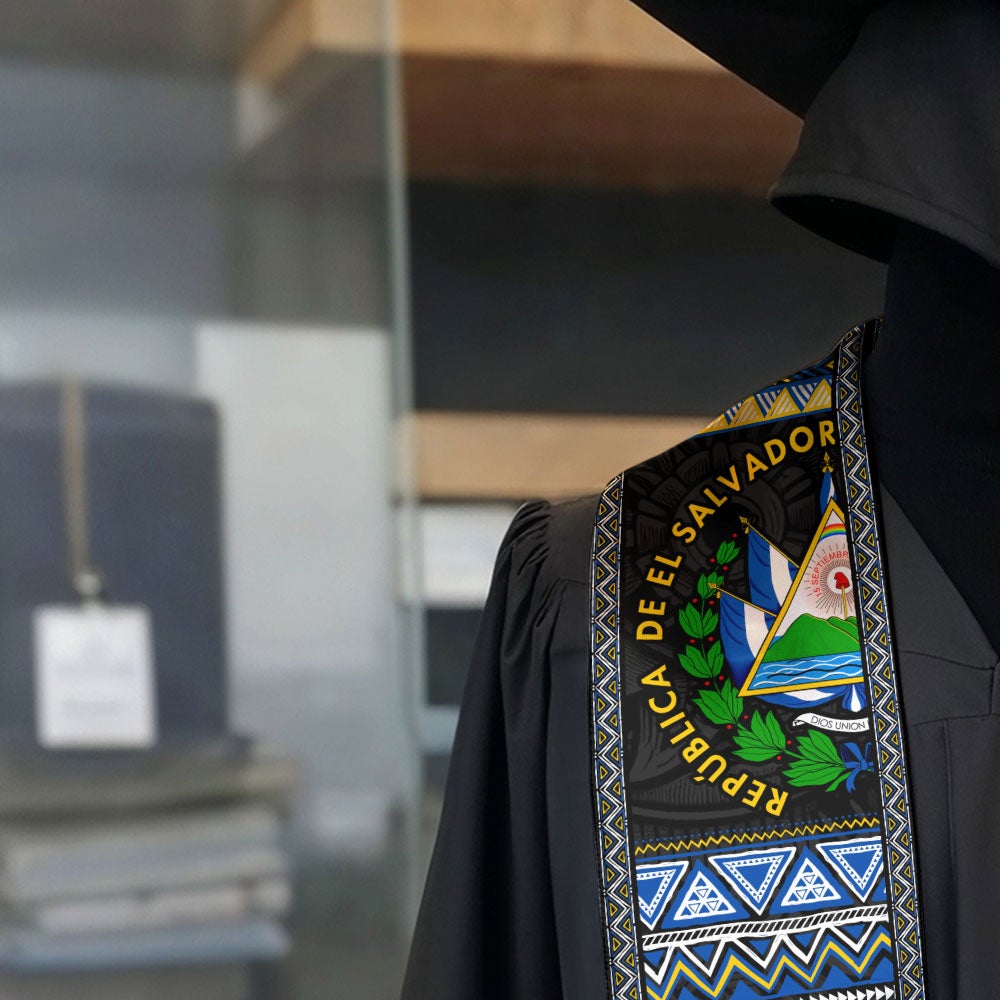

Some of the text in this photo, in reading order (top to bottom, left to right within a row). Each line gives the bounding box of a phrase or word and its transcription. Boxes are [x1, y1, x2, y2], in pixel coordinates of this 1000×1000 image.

[636, 420, 836, 816] REPÚBLICA DE EL SALVADOR
[810, 715, 866, 731] DIOS UNION
